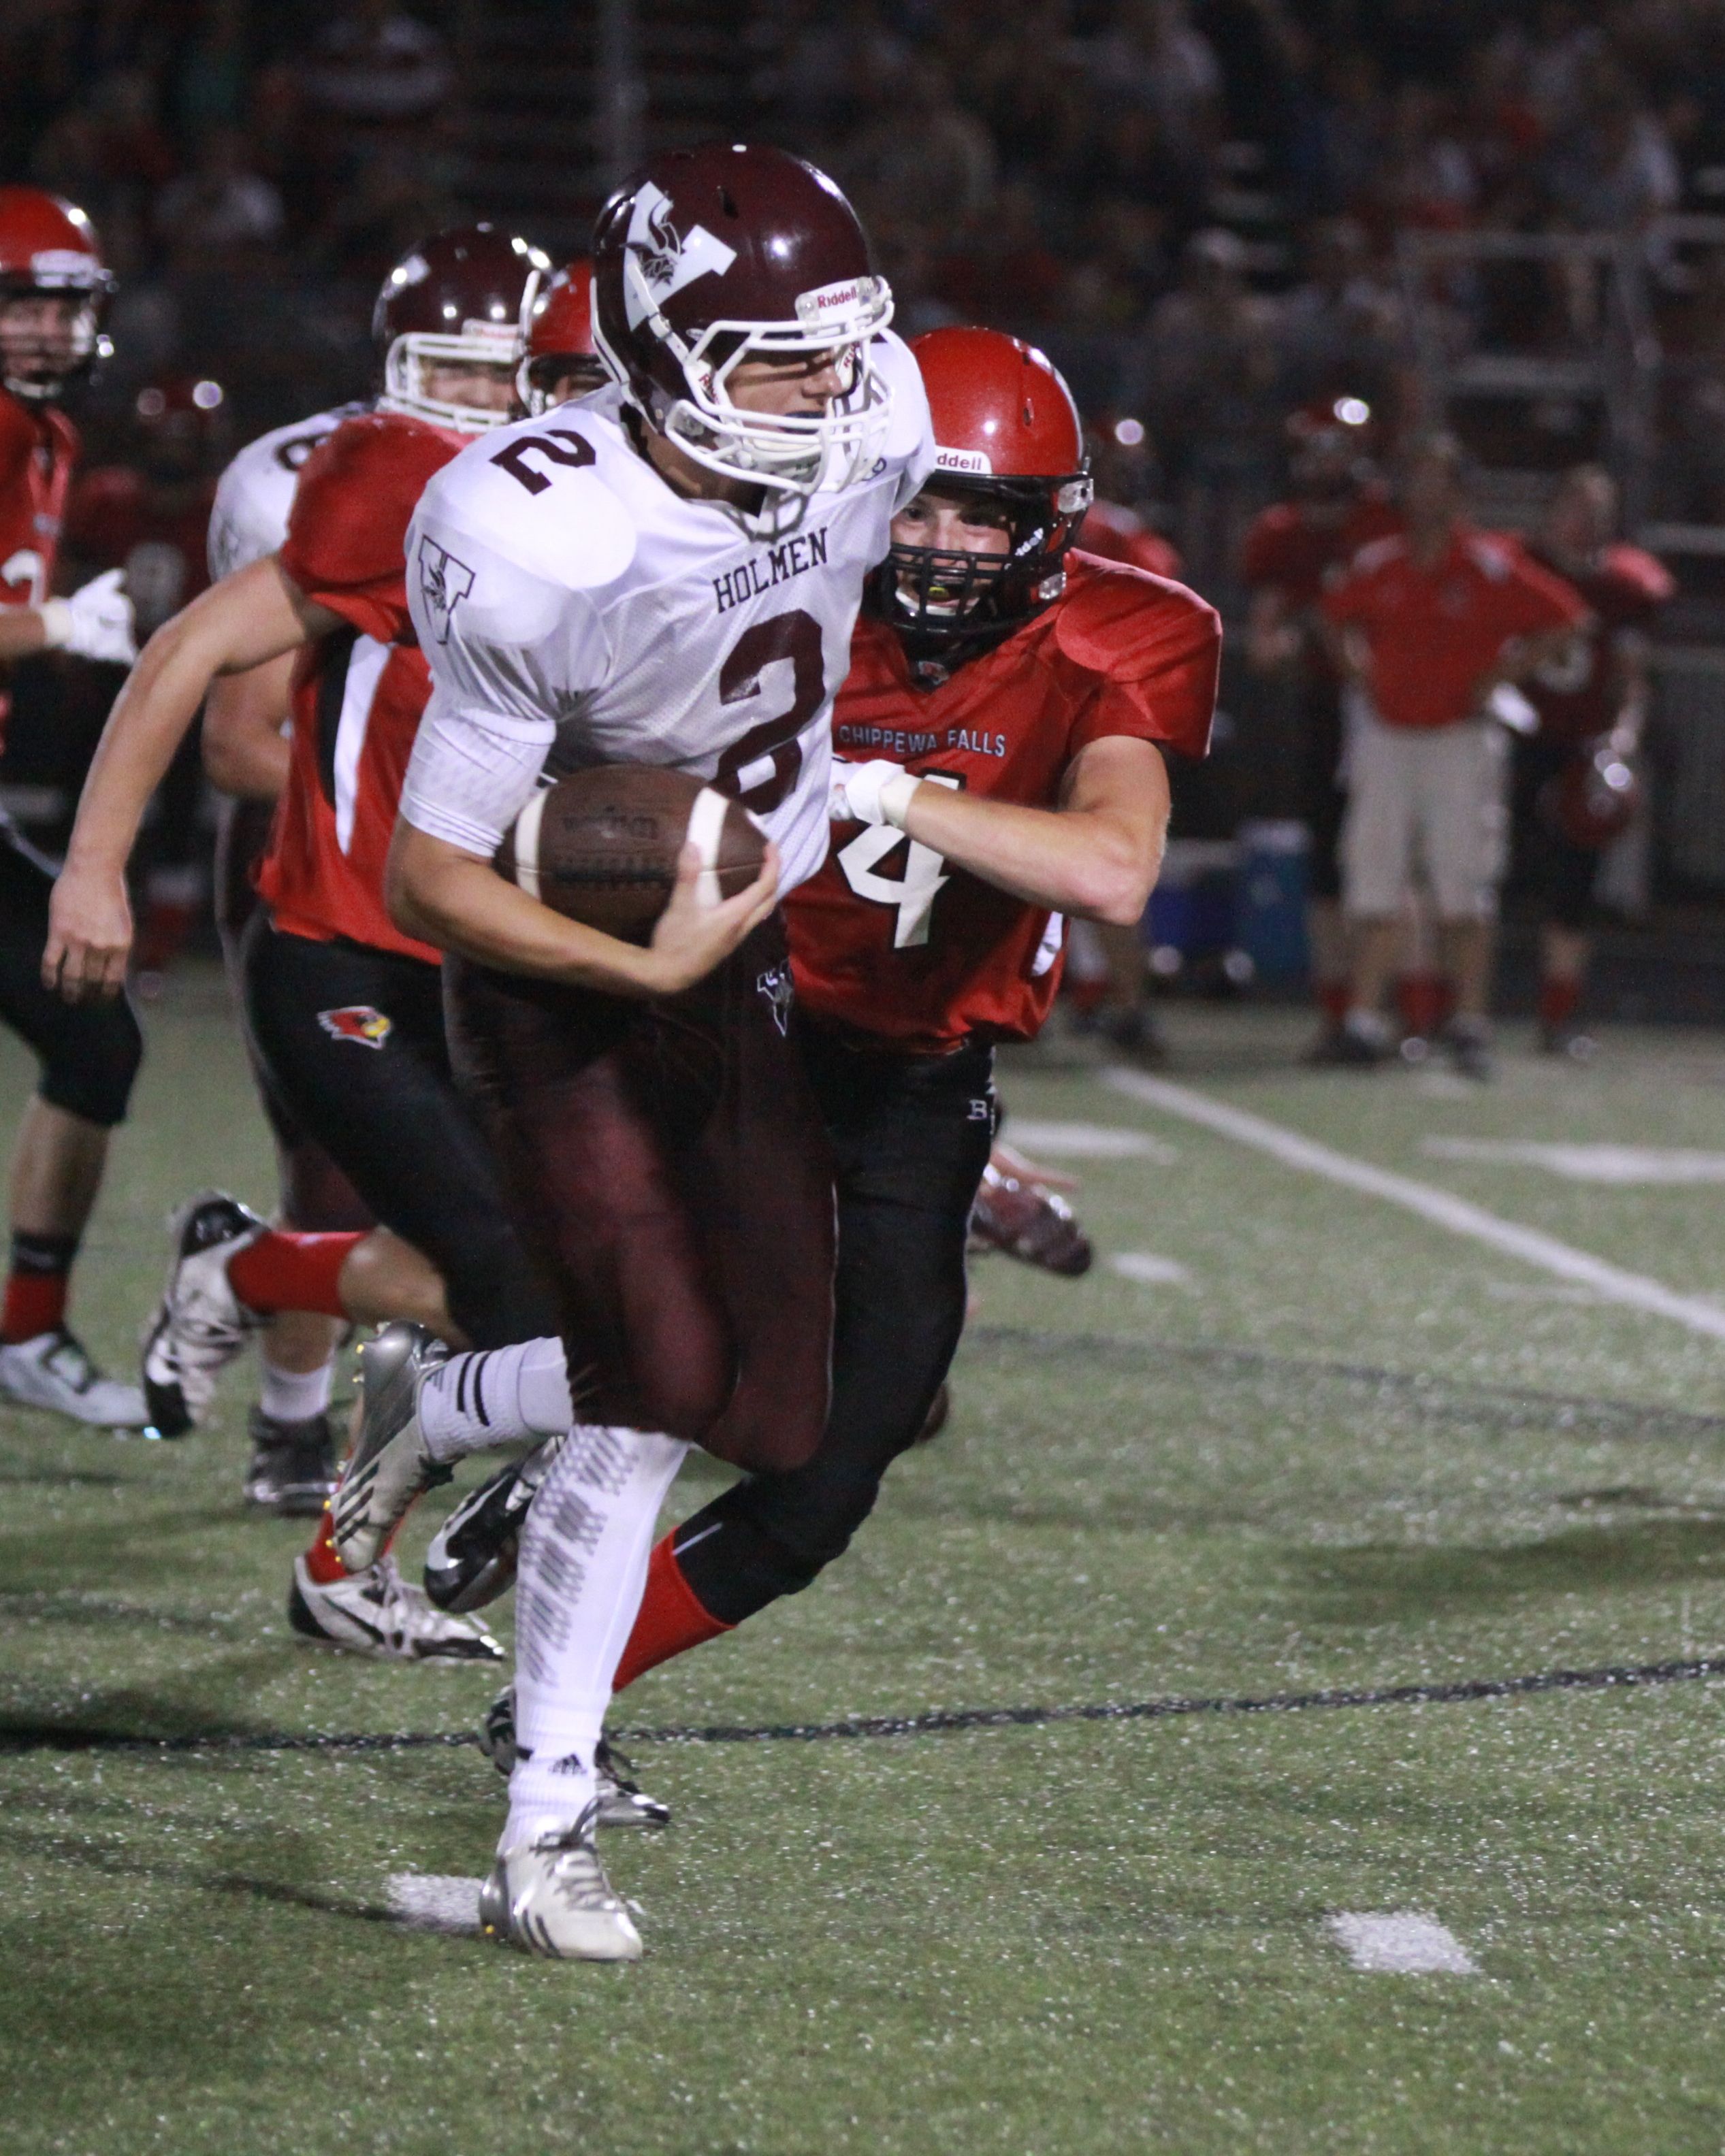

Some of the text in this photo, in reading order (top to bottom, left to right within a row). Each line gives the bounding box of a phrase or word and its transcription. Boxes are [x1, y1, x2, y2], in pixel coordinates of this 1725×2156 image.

[817, 286, 858, 308] Riddell
[490, 429, 596, 495] 2
[937, 453, 982, 471] ddell
[713, 527, 827, 613] HOLMEN
[716, 608, 826, 816] 2
[839, 725, 1006, 757] CHIPPEWA FALLS
[837, 769, 962, 949] 4
